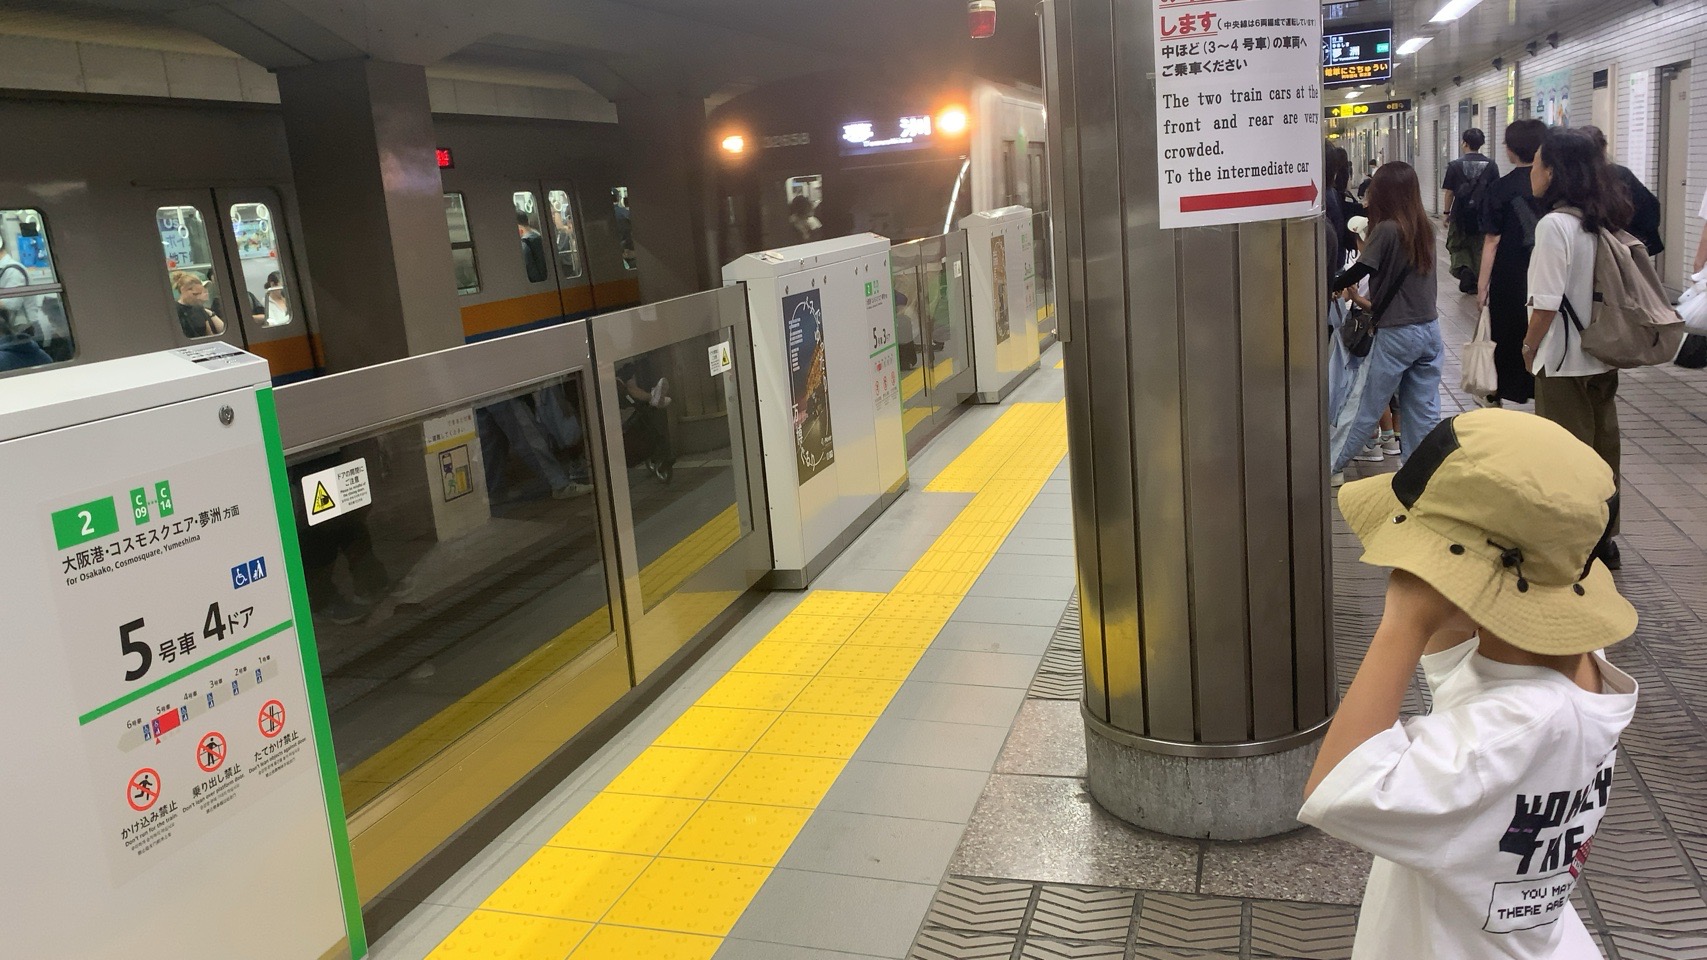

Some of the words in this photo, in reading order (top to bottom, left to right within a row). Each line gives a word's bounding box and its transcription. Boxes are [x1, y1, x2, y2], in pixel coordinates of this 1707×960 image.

[1161, 11, 1216, 36] します
[1162, 58, 1248, 77] ご乗車ください
[1163, 94, 1189, 109] The
[1198, 92, 1222, 105] two
[1230, 88, 1262, 103] train
[1269, 88, 1291, 100] cars
[1296, 85, 1305, 99] at
[1308, 84, 1318, 99] the
[1163, 118, 1201, 134] front
[1213, 114, 1238, 130] and
[1248, 114, 1274, 127] rear
[1283, 113, 1298, 124] are
[1304, 113, 1318, 124] very
[1164, 141, 1224, 159] crowded.
[1165, 170, 1182, 184] To
[1188, 167, 1211, 182] the
[1217, 161, 1294, 180] intermediate
[1297, 162, 1310, 173] car
[135, 494, 142, 506] C
[160, 488, 167, 498] C
[134, 506, 148, 519] 09
[160, 499, 172, 511] 14
[77, 510, 95, 536] 2
[66, 575, 78, 586] for
[79, 564, 114, 582] Osakako,
[114, 547, 163, 570] Cosmosquare,
[164, 534, 201, 552] Yumeshima
[254, 730, 299, 762] たてかけ禁止
[192, 763, 241, 799] 乗り出し禁止
[121, 800, 178, 840] かけ込み禁止
[1522, 888, 1548, 900] YOU
[1552, 881, 1574, 897] MAY
[1497, 904, 1542, 920] THERE
[1545, 896, 1565, 912] ARE
